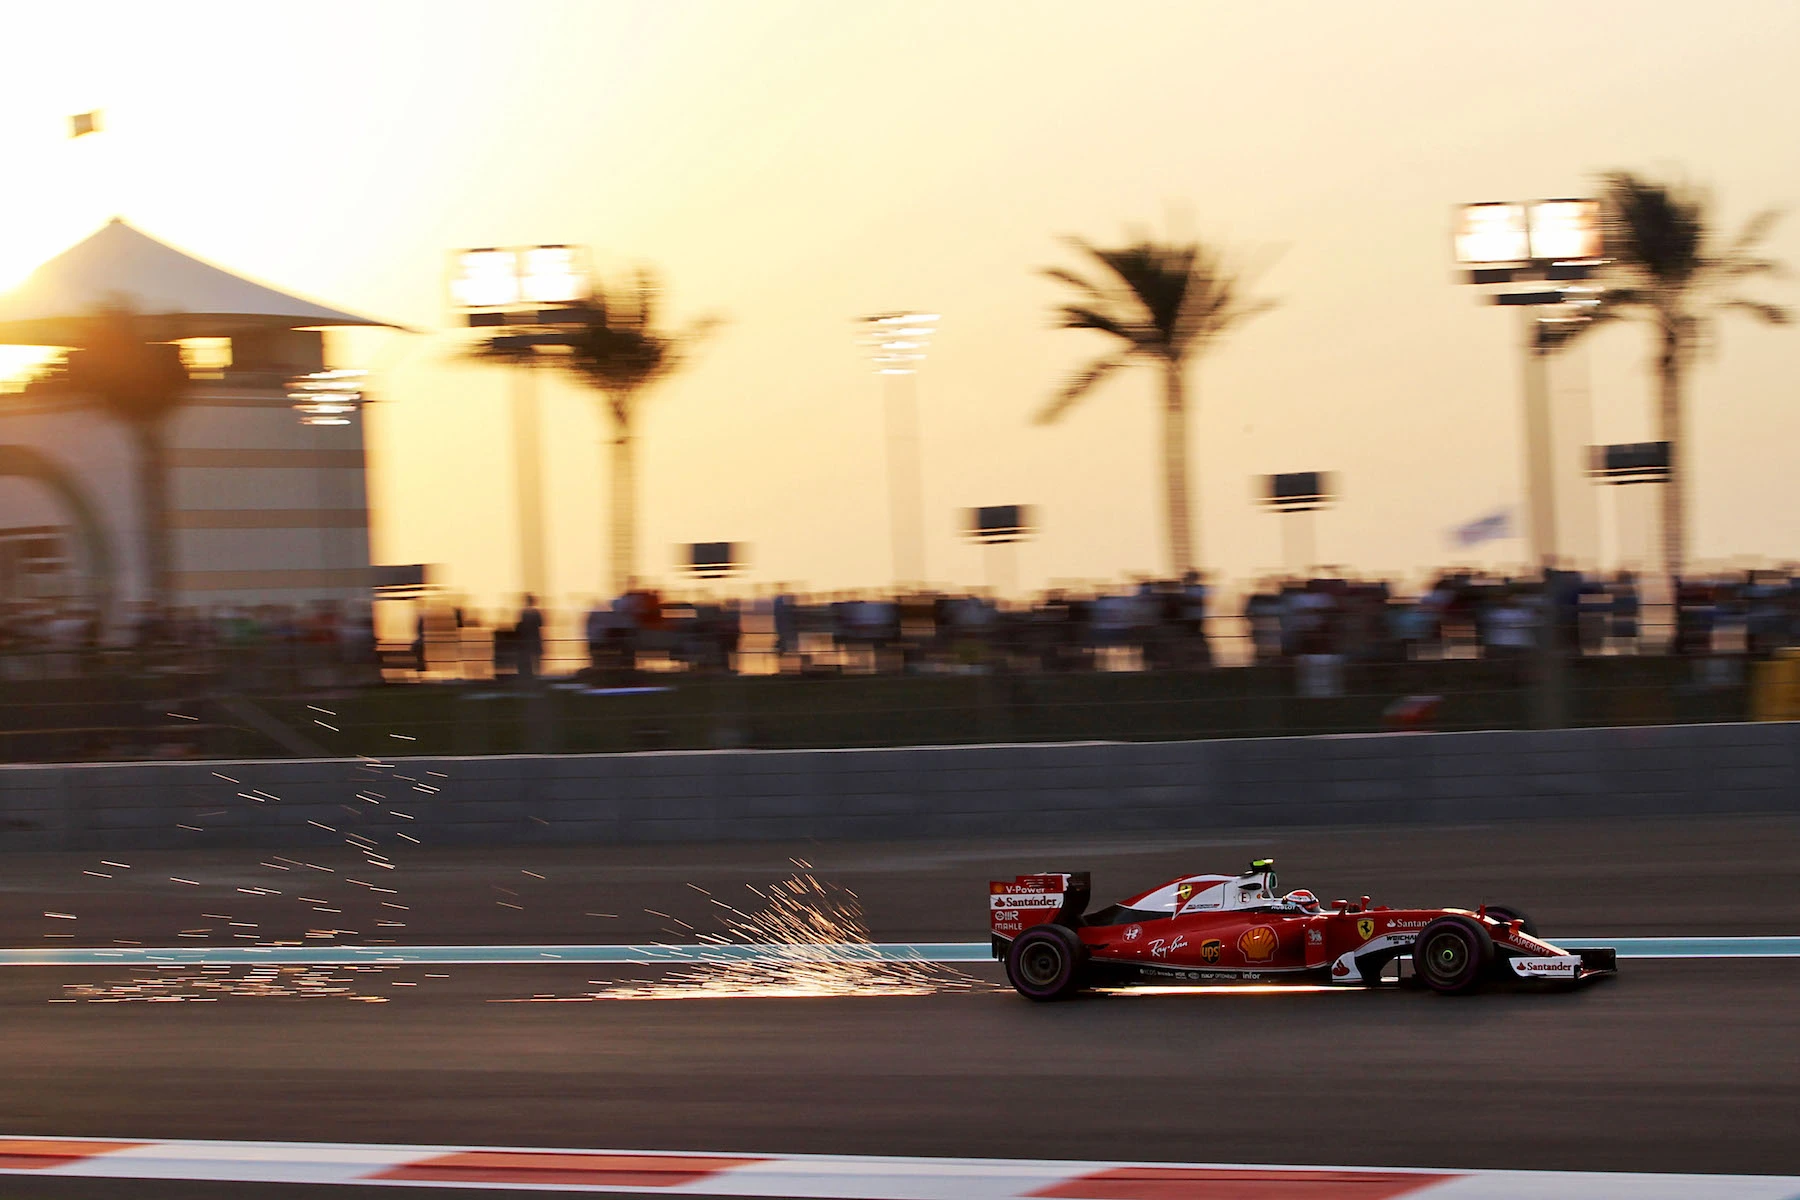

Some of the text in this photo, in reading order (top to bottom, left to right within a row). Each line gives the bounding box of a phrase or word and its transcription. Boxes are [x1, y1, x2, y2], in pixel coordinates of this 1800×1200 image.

[1006, 886, 1045, 894] V-Power
[1006, 896, 1057, 907] Santander
[1148, 935, 1188, 958] Ray-Ban
[1508, 934, 1545, 953] KASPERSKY
[1527, 962, 1572, 971] Santander
